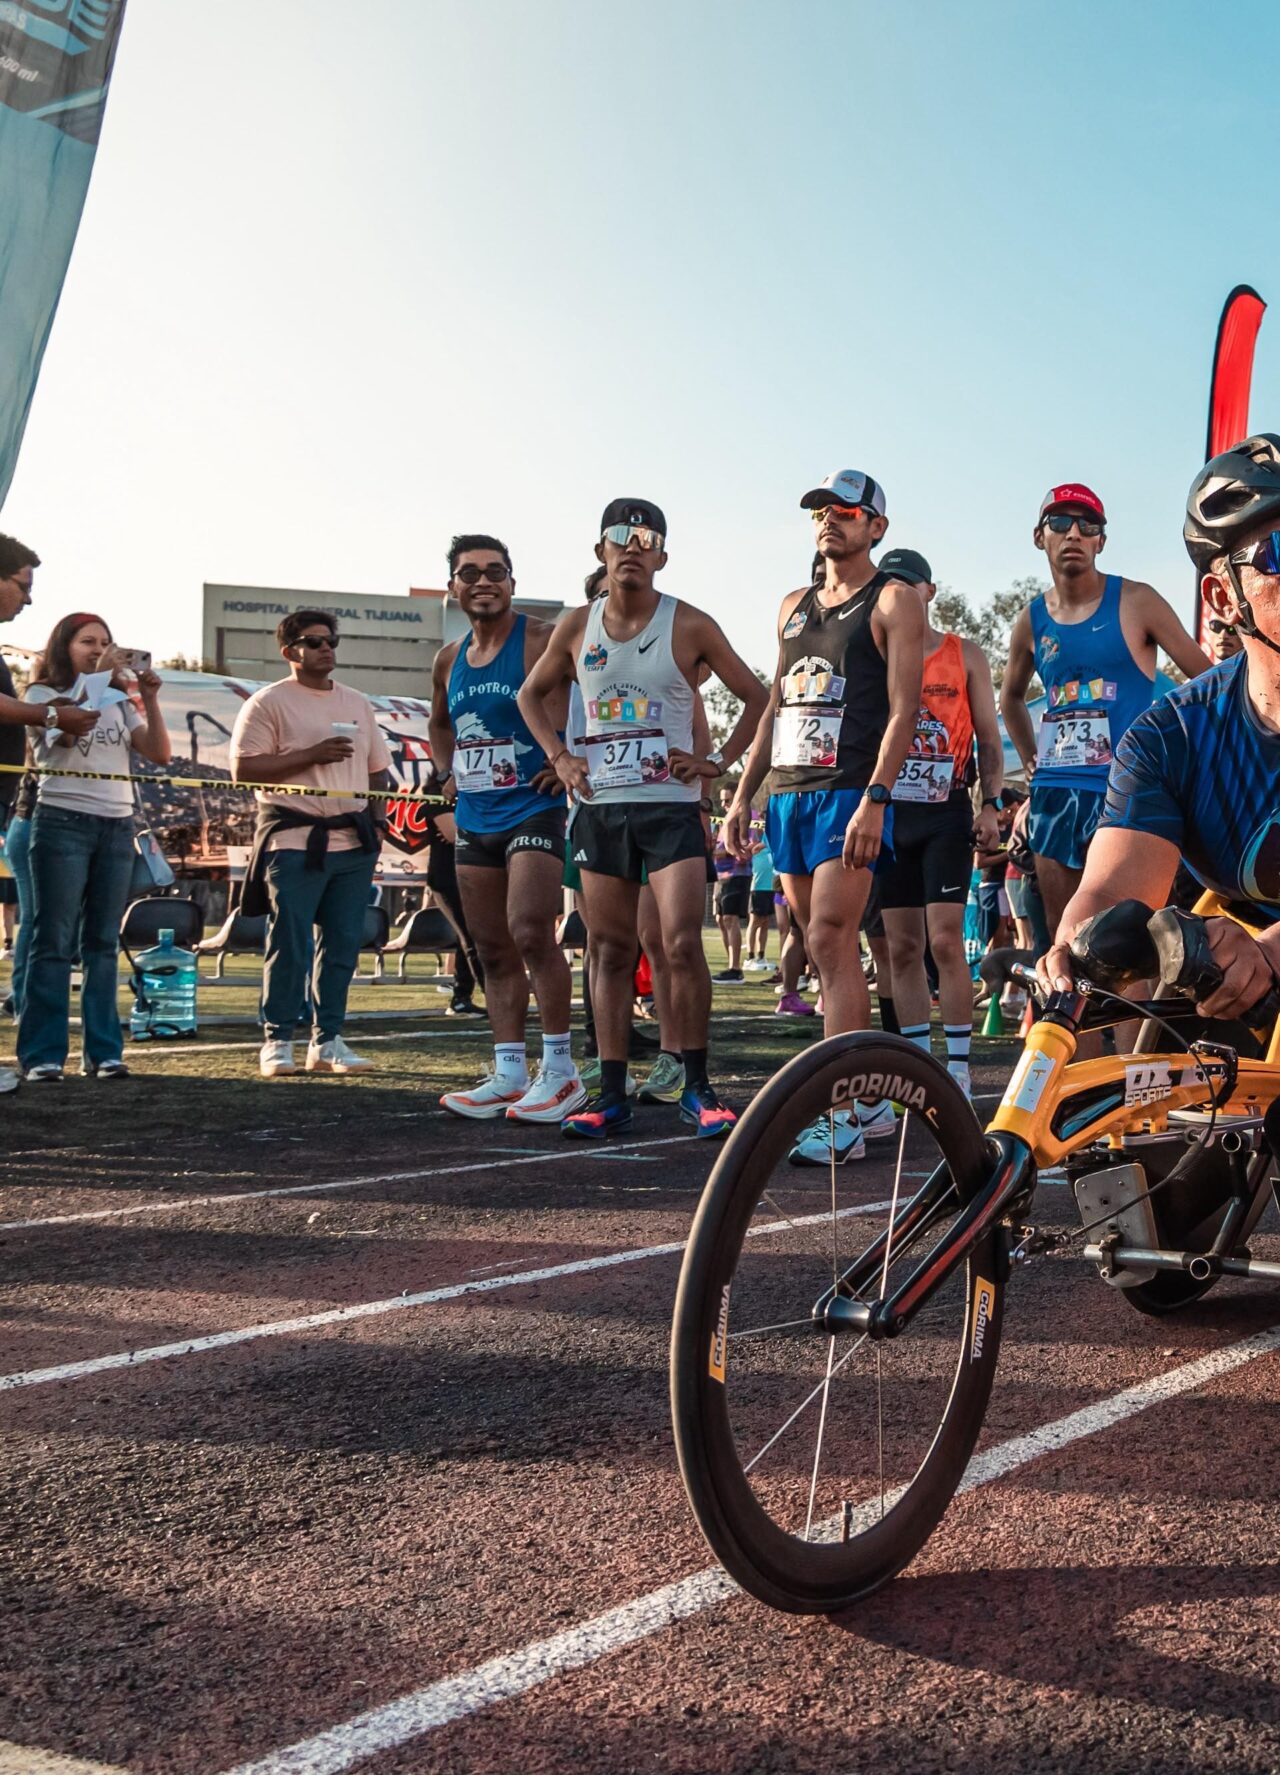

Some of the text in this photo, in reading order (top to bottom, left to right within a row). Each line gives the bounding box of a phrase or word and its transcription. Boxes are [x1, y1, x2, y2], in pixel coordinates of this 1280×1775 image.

[223, 600, 289, 615] HOSPITAL
[364, 608, 423, 623] TIJUANA
[468, 681, 518, 700] POTROS
[1054, 720, 1092, 744] 373
[465, 748, 495, 770] 171
[603, 740, 643, 765] 371
[831, 1073, 926, 1110] CORIMA
[1125, 1085, 1172, 1108] SPORTS
[714, 1284, 730, 1367] CORIMA
[972, 1290, 989, 1358] CORIMA
